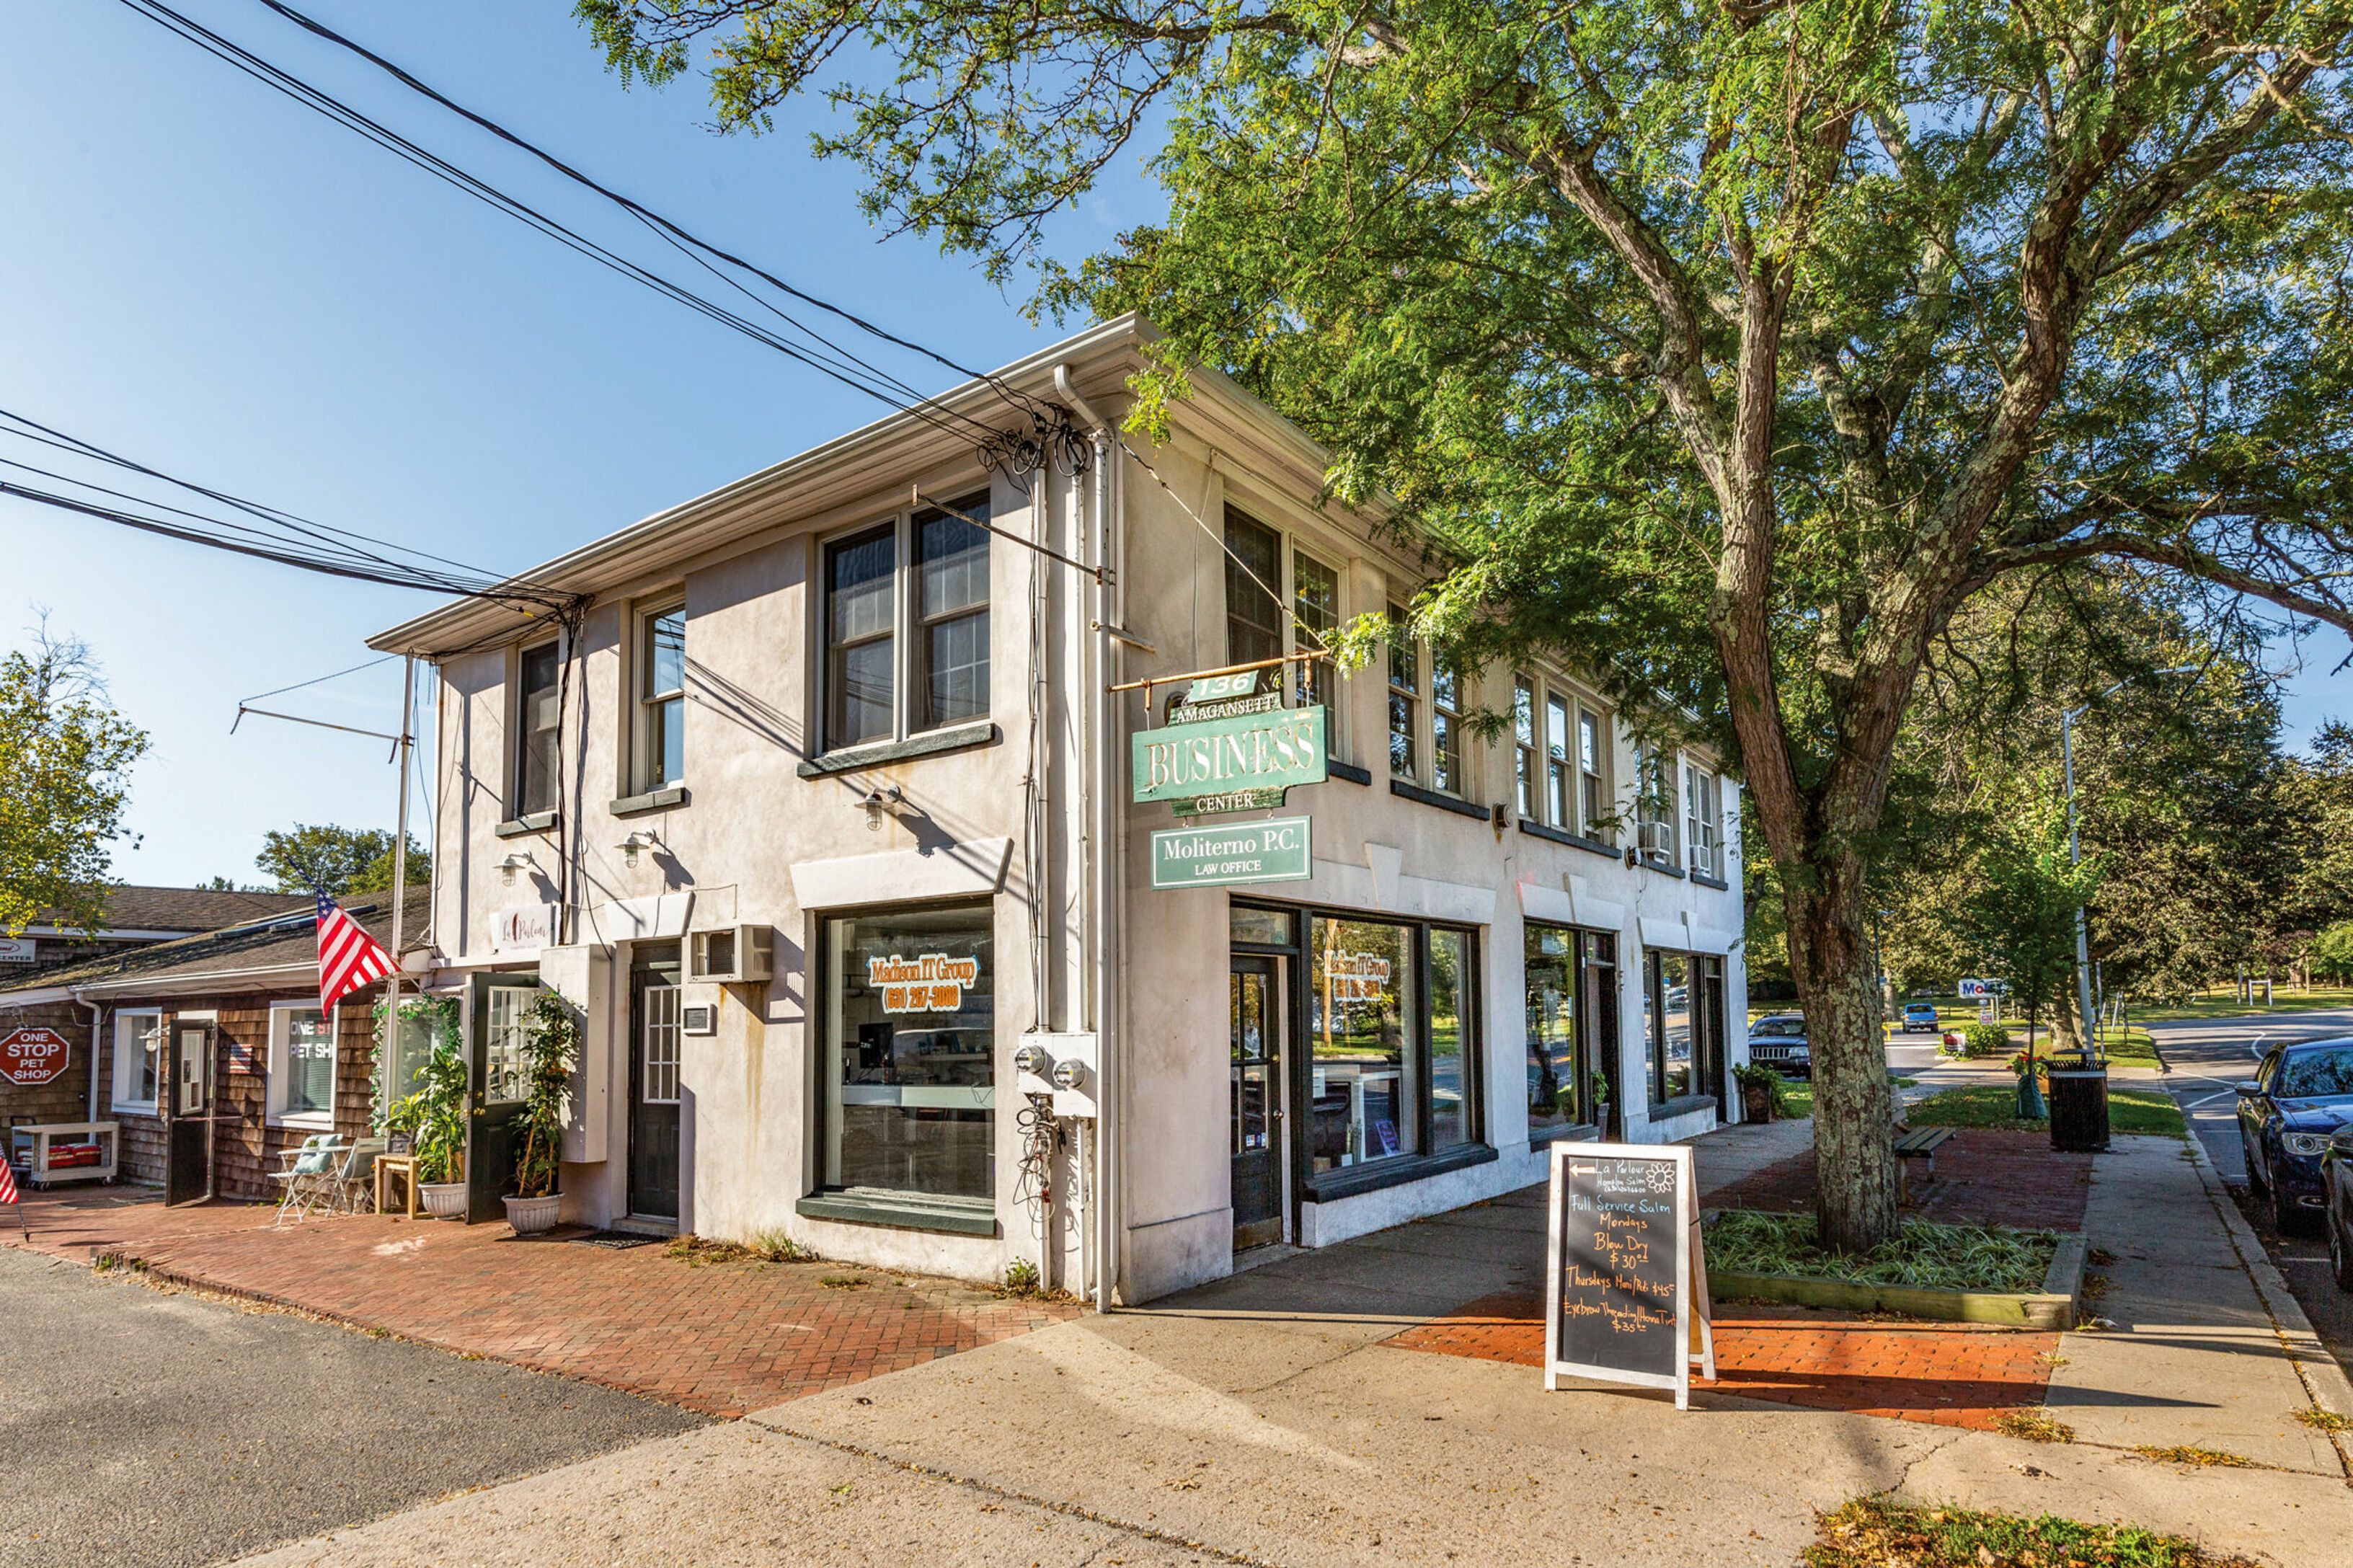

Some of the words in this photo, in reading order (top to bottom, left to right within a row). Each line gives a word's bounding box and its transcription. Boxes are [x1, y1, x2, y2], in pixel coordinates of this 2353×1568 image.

[1200, 673, 1251, 696] 136
[1176, 696, 1275, 723] AMAGANSETT
[1145, 723, 1315, 787] BUSINESS
[1197, 794, 1254, 812] CENTER
[1164, 837, 1256, 860] Moliterno
[1263, 828, 1299, 851] P.C.
[1195, 864, 1218, 876] LAW
[1220, 860, 1262, 874] OFFICE
[872, 958, 921, 983] Madison
[921, 958, 936, 980] IT
[936, 957, 975, 985] Group
[884, 987, 908, 1009] (631)
[20, 1033, 49, 1042] ONE
[291, 1021, 314, 1035] ONE
[316, 1020, 332, 1035] ST
[7, 1044, 60, 1057] STOP
[290, 1043, 311, 1058] PET
[315, 1043, 332, 1058] SH
[20, 1058, 46, 1068] PET
[14, 1069, 51, 1079] SHOP
[1595, 1159, 1610, 1174] La
[1617, 1159, 1644, 1174] Parlour
[1572, 1195, 1590, 1211] Full
[1597, 1195, 1635, 1213] Service
[1639, 1199, 1670, 1214] Salon
[1600, 1211, 1648, 1233] Mondays
[1594, 1231, 1623, 1251] Blow
[1626, 1235, 1648, 1259] Dry
[1565, 1264, 1611, 1295] Thursdays
[1564, 1294, 1600, 1319] Eyebrow
